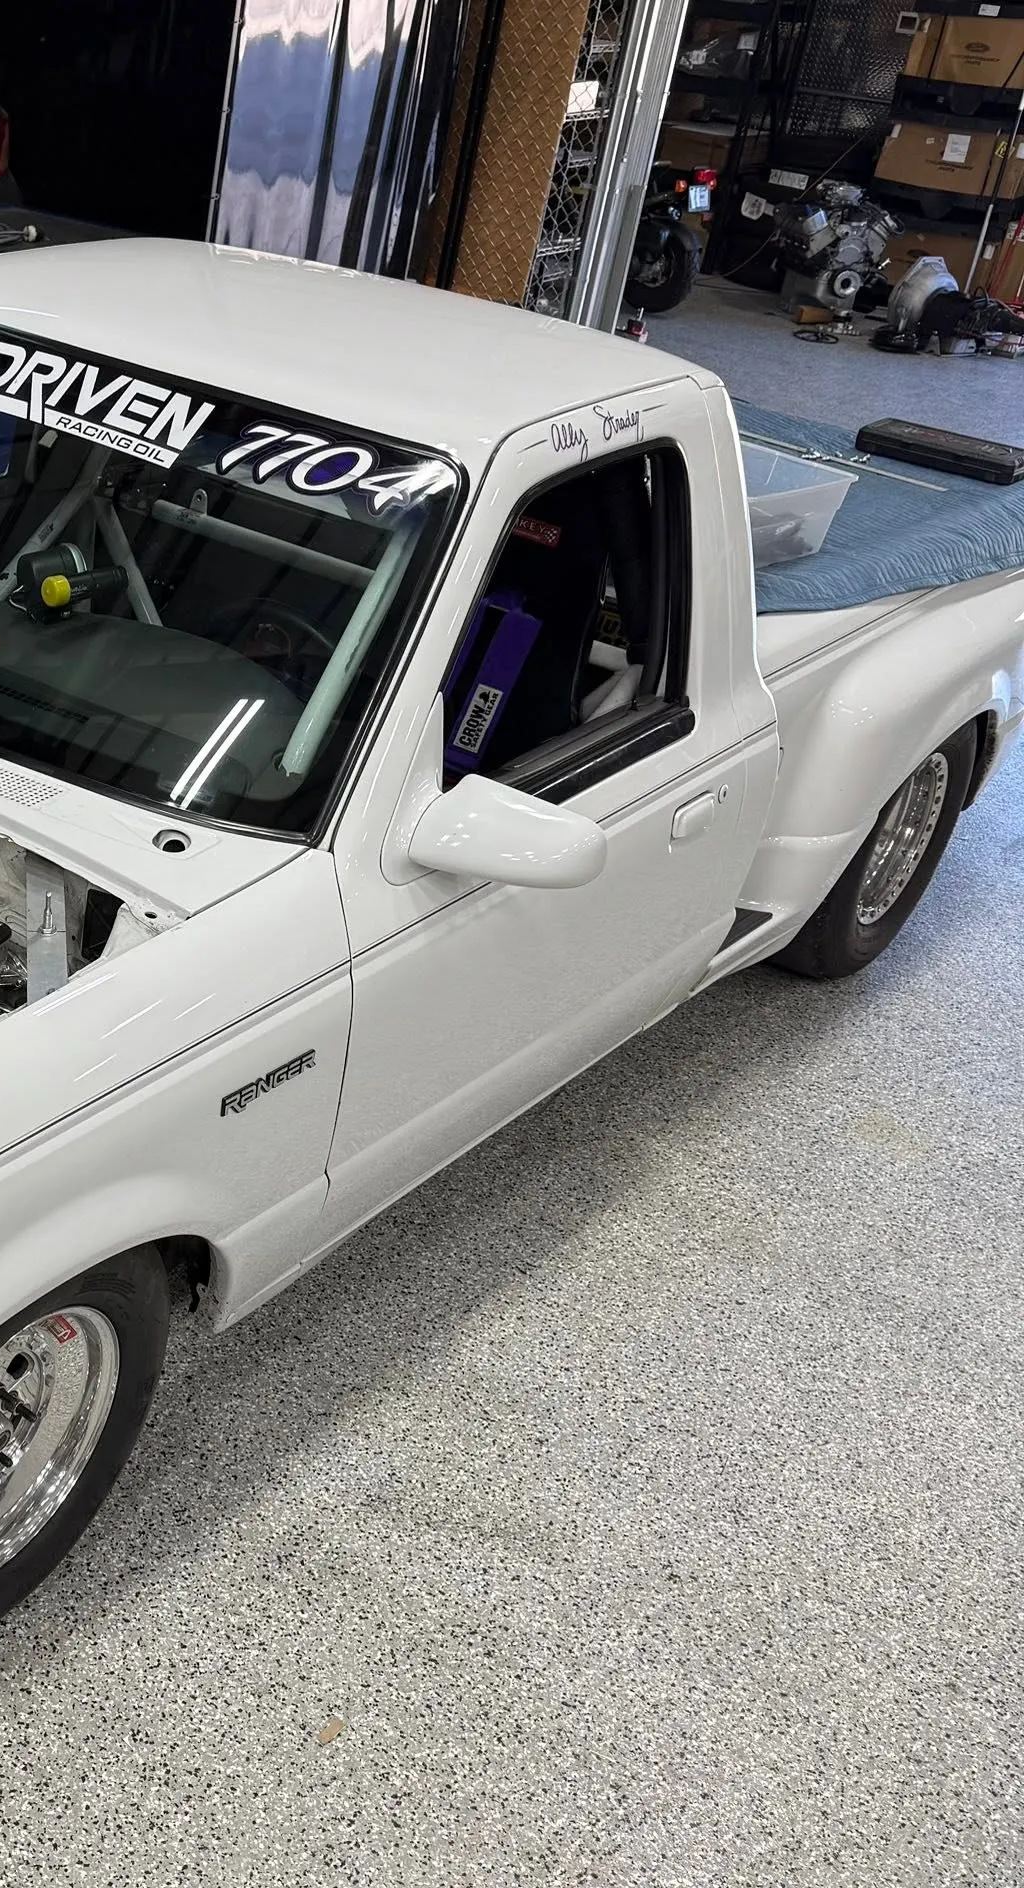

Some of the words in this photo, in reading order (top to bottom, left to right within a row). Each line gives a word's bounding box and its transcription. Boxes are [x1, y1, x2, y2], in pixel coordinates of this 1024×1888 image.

[56, 416, 133, 449] RACING
[132, 443, 165, 463] OIL
[551, 422, 589, 462] Ally
[217, 420, 438, 515] 7704
[458, 703, 486, 747] CROW
[470, 716, 488, 749] SAFETY
[485, 692, 499, 716] GEAR
[220, 1048, 317, 1117] RANGER
